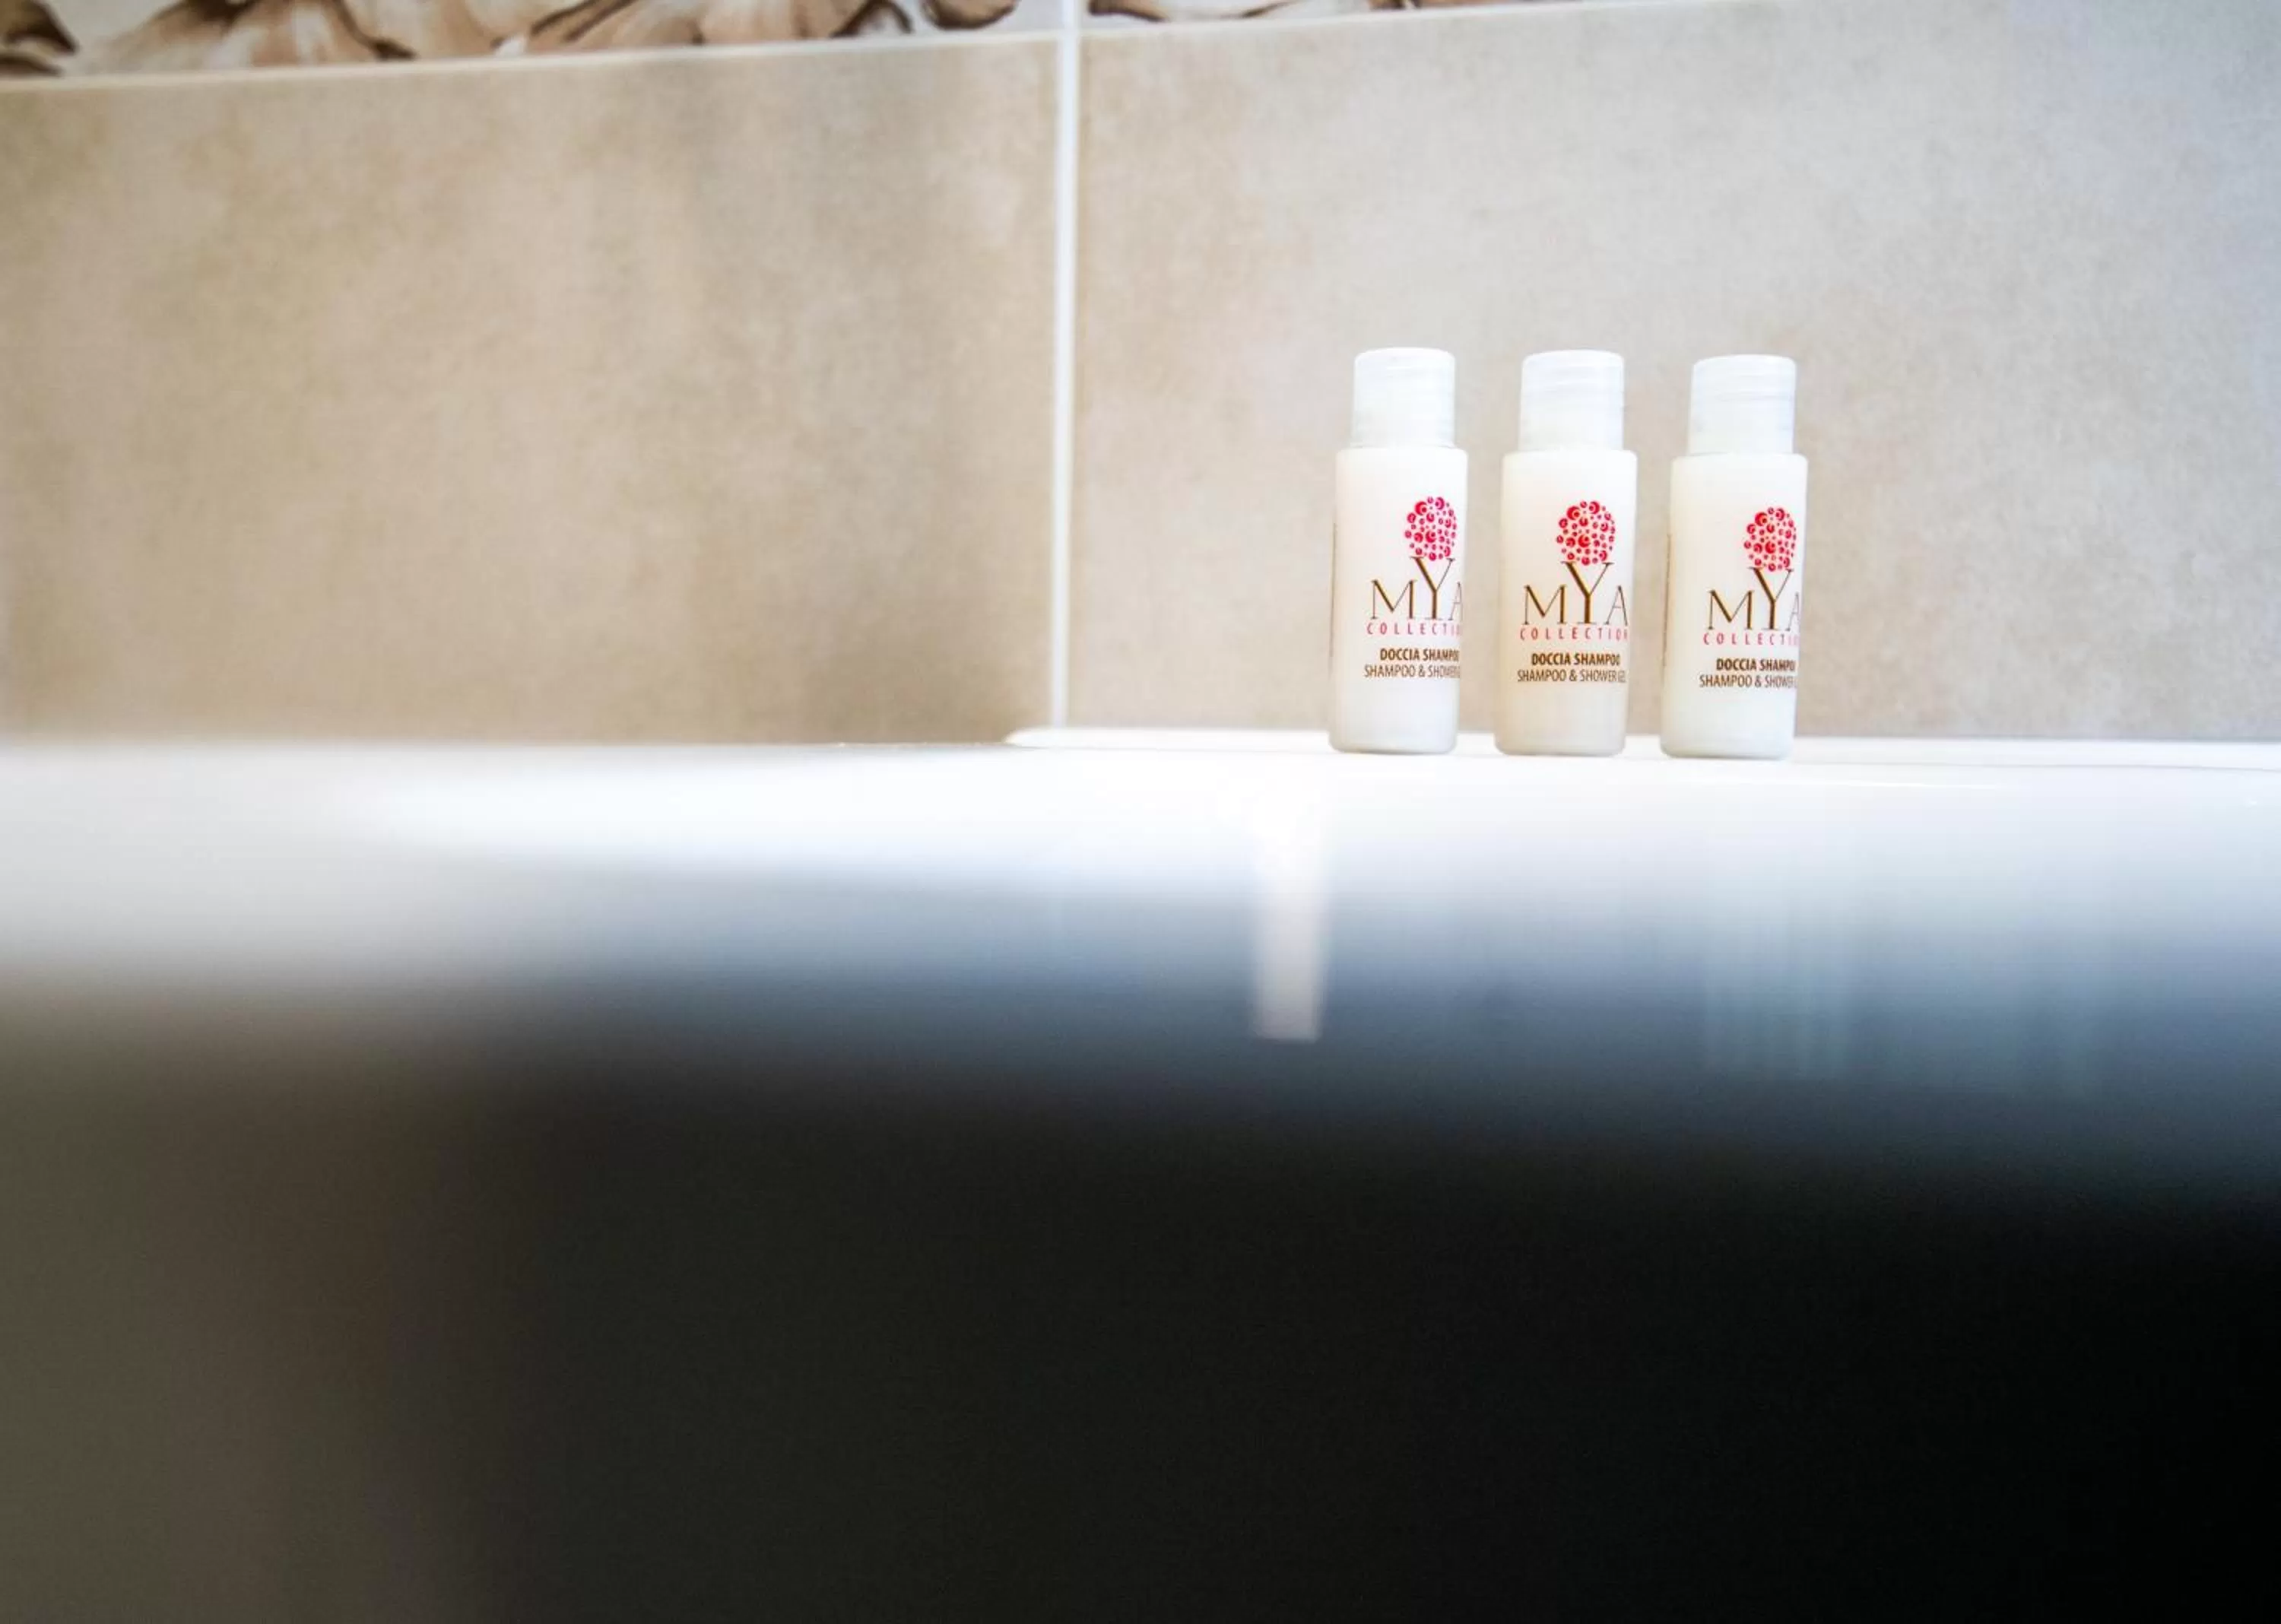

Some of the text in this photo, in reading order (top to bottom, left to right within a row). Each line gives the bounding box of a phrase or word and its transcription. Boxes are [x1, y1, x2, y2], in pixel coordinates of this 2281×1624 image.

[1370, 556, 1463, 621] MYA
[1521, 560, 1629, 626] MYA
[1708, 566, 1800, 631] MYA
[1366, 622, 1461, 636] COLLECTI
[1702, 632, 1799, 646] COLLECTI
[1380, 648, 1460, 662] DOCCIA SHAMPO
[1531, 652, 1621, 666] DOCCIA SHAMPOO
[1364, 664, 1416, 677] SHAMPOO
[1418, 664, 1426, 678] &
[1715, 658, 1796, 672] DOCCIA SHAMPO
[1518, 668, 1566, 682] SHAMPOO
[1569, 668, 1578, 682] &
[1579, 668, 1617, 683] SHOWER
[1699, 674, 1753, 687] SHAMPOO
[1754, 674, 1762, 688] &
